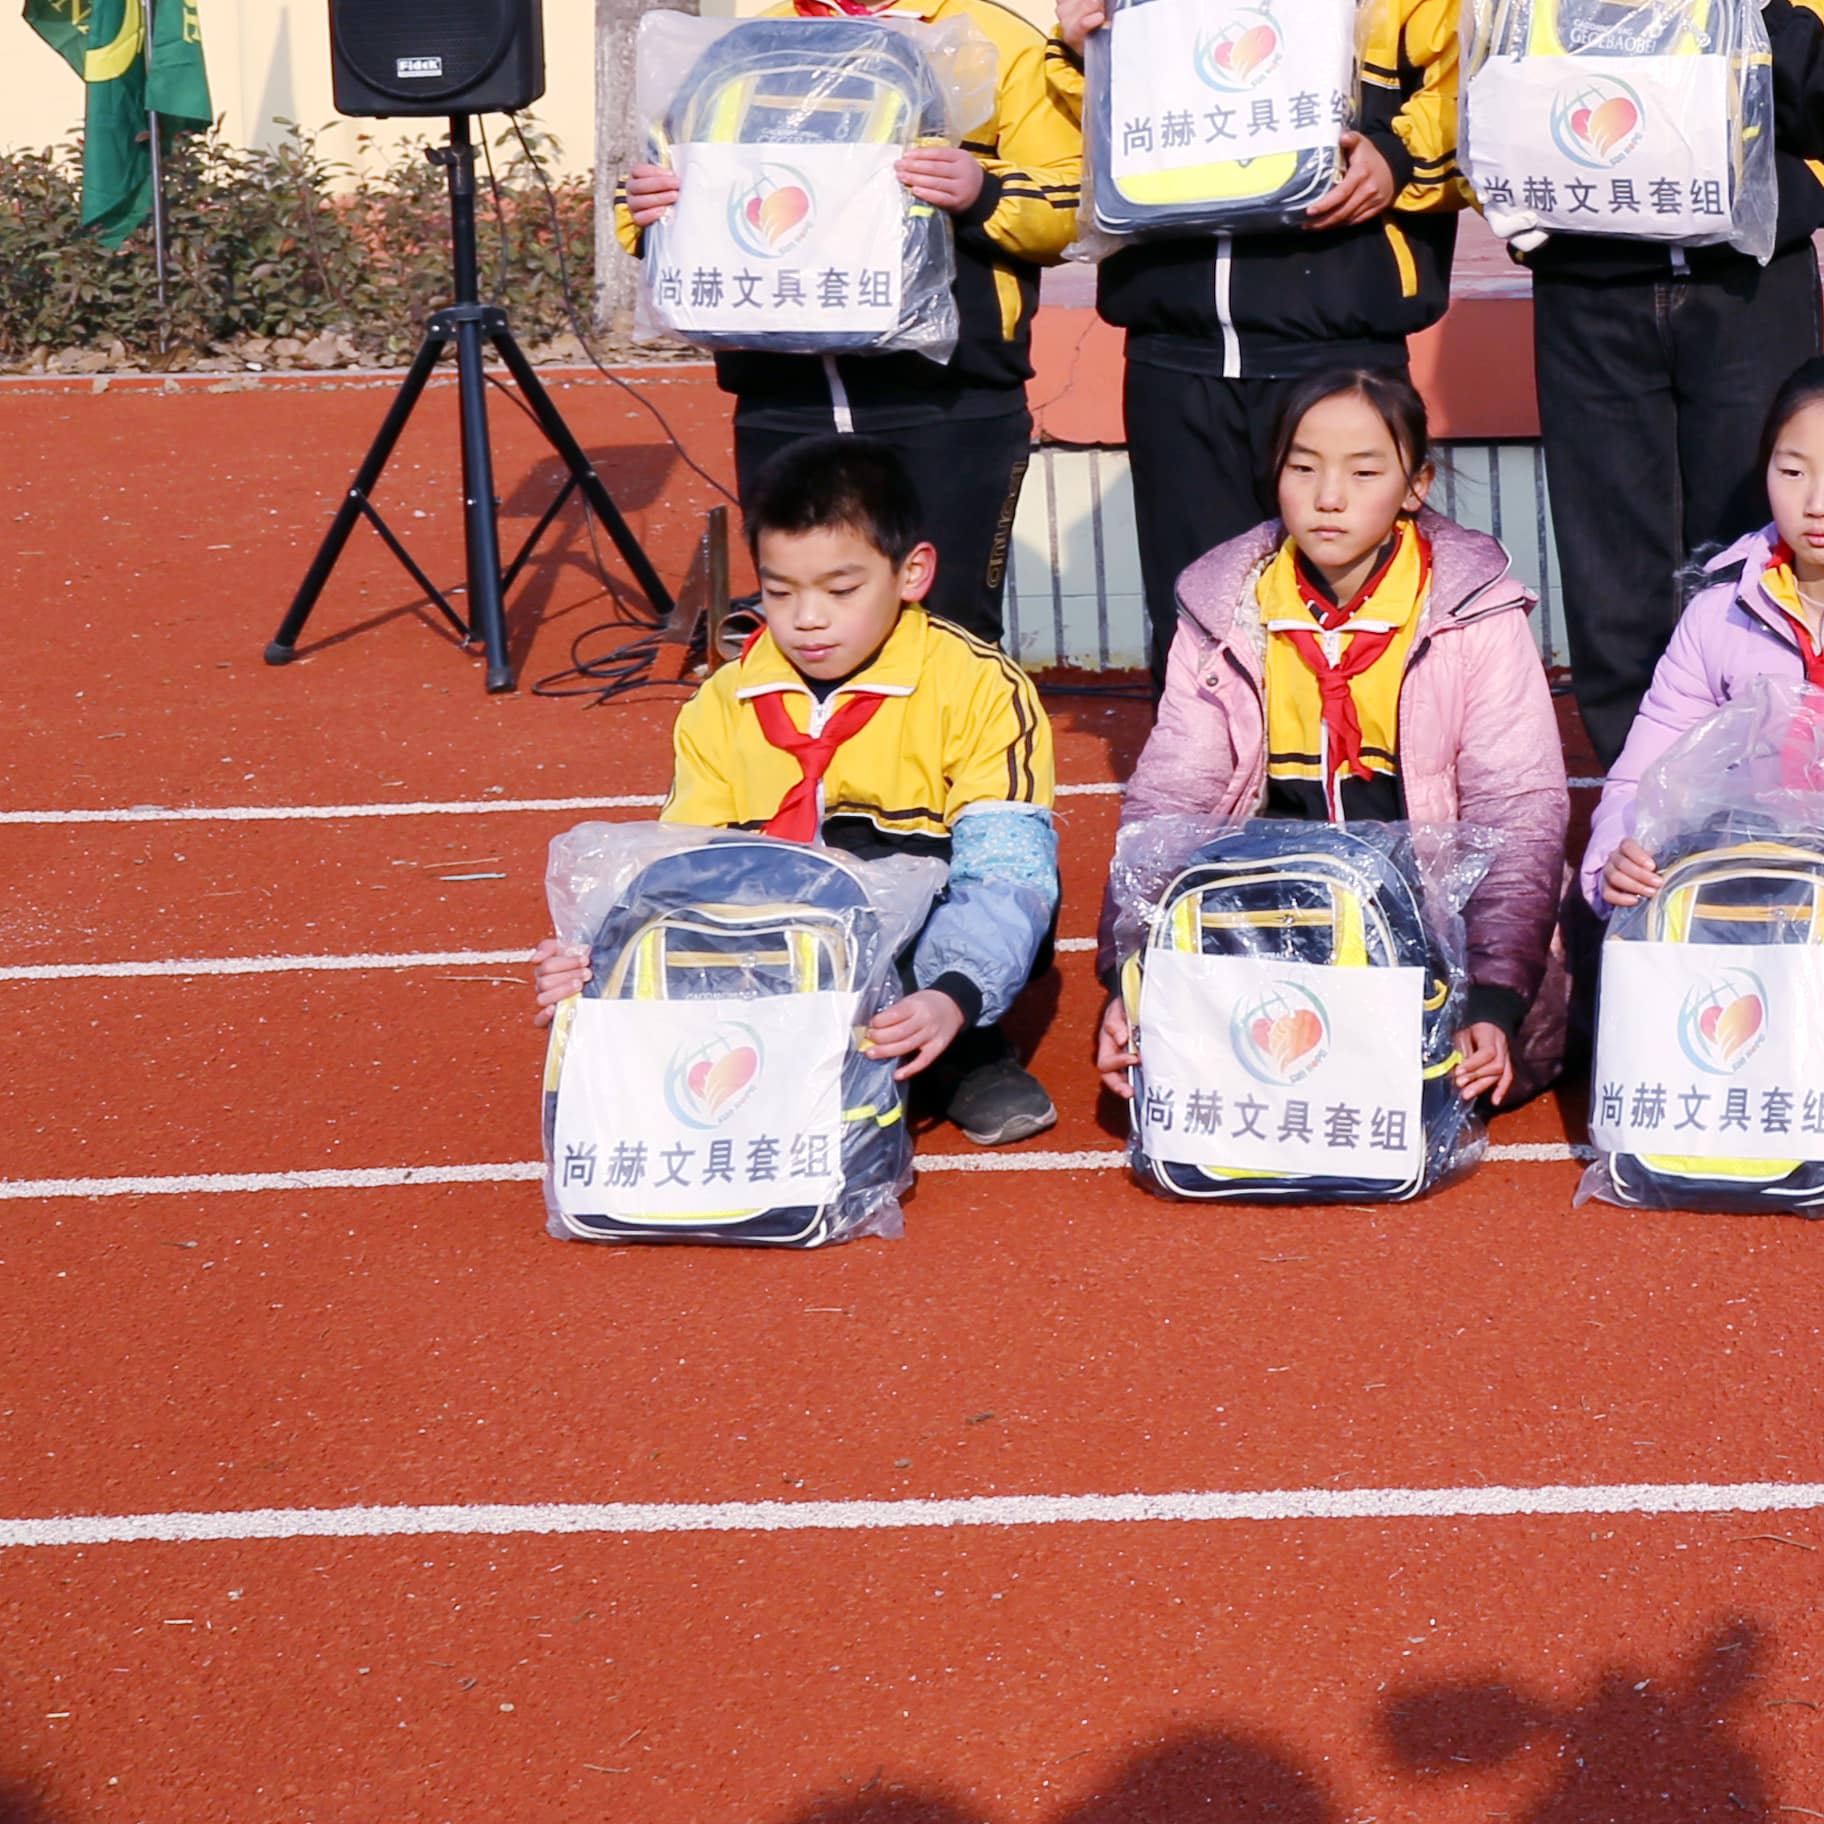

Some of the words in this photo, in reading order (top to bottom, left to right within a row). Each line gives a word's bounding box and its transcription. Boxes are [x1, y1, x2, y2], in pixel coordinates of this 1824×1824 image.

[1483, 175, 1725, 218] 尚赫文具套组
[658, 268, 893, 309] 尚赫文具套组
[1146, 1085, 1409, 1153] 尚赫文具套组
[562, 1134, 832, 1190] 尚赫文具套组
